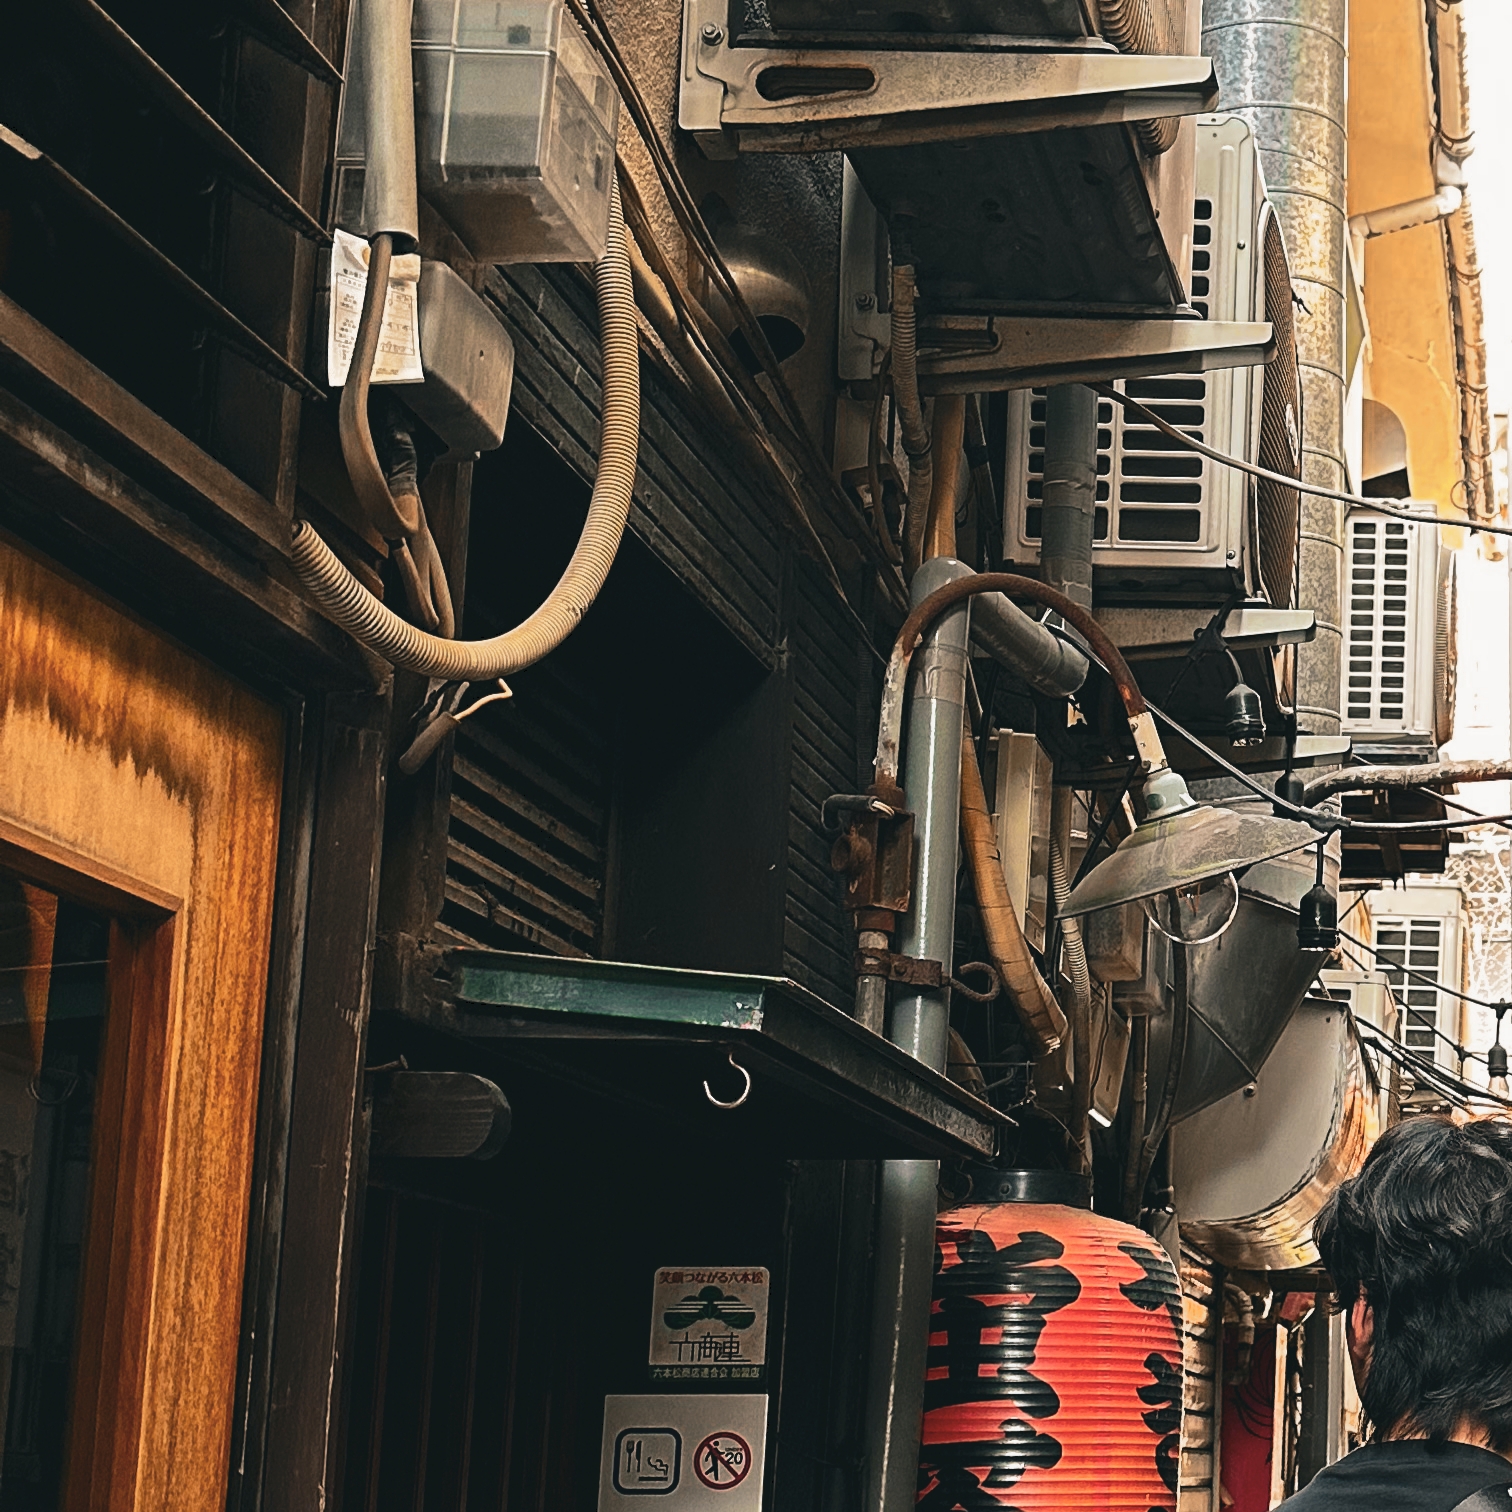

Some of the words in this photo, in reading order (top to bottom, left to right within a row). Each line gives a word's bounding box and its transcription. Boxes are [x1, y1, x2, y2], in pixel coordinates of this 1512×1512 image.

[659, 1271, 764, 1285] 笑顔つながる六本松
[724, 1452, 744, 1465] 20
